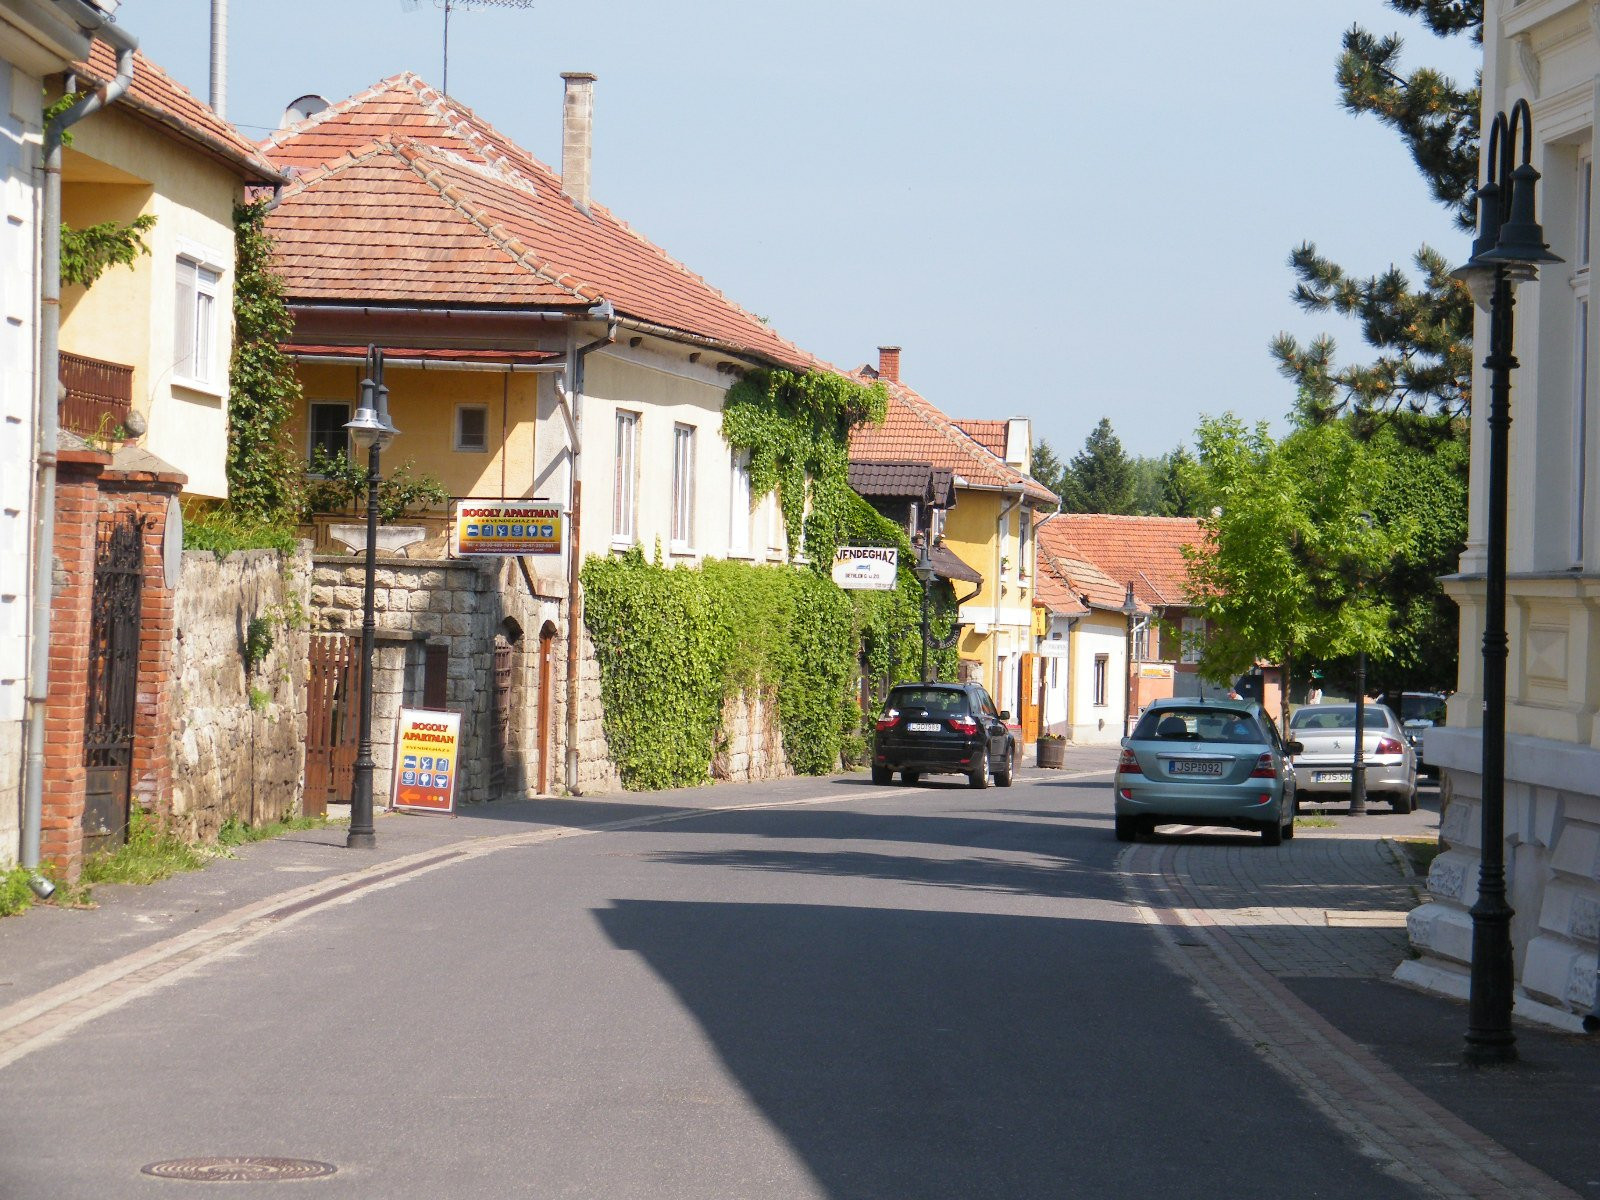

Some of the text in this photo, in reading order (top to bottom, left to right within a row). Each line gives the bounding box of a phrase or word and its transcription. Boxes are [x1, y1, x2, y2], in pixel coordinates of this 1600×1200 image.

[462, 508, 559, 518] BOGOLY APARTMAN
[412, 722, 448, 732] BOGOLY
[403, 732, 454, 744] APARTMAN
